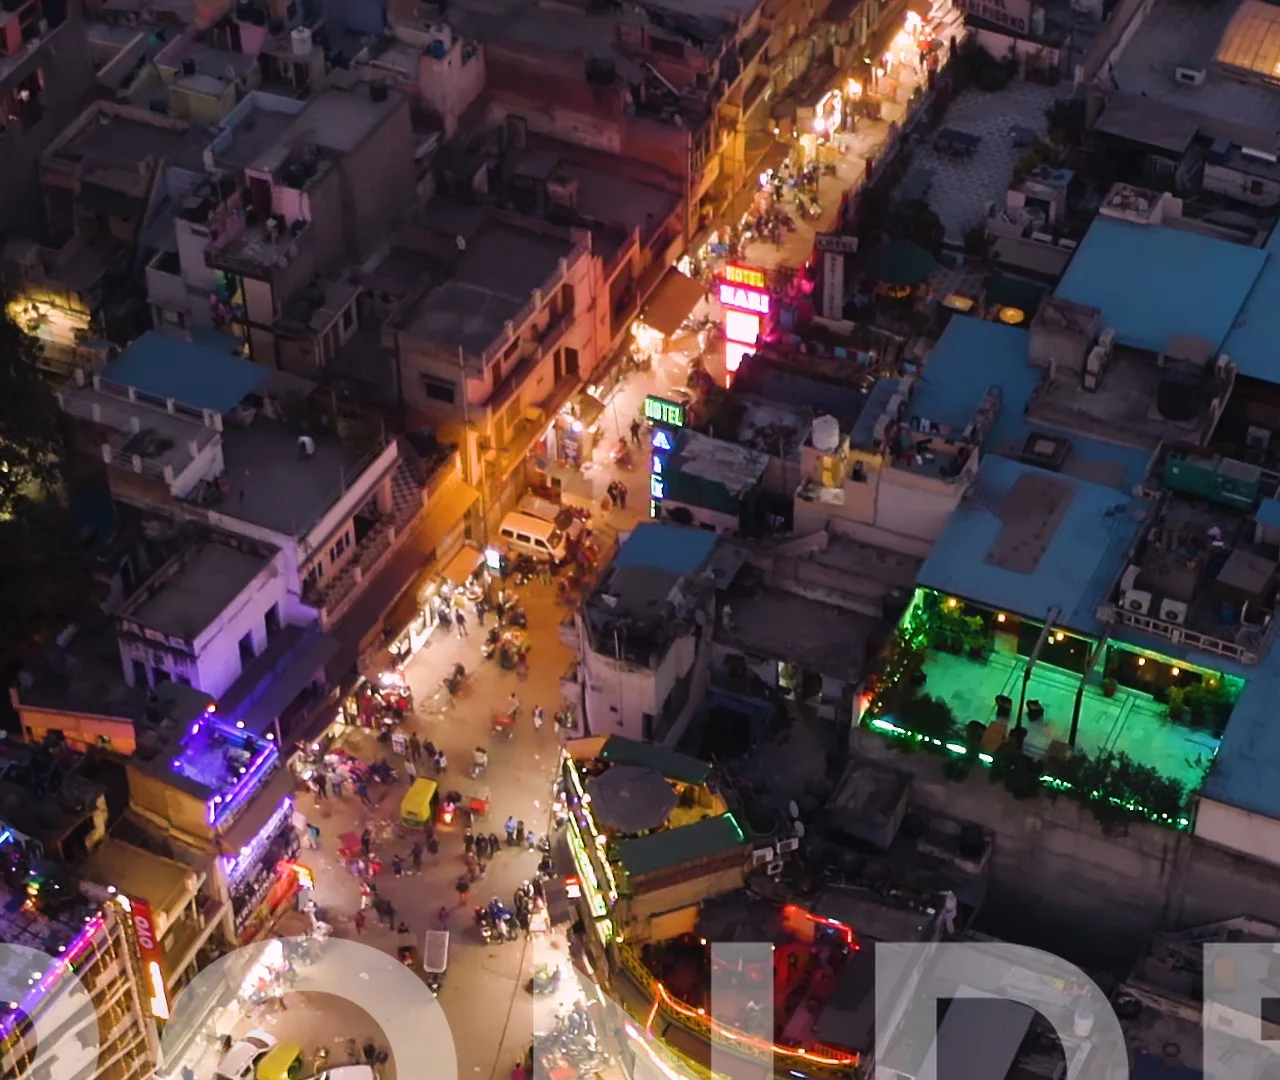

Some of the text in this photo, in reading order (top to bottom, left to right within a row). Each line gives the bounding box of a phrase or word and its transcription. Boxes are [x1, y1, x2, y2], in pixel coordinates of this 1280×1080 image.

[725, 264, 765, 287] HOTEL
[644, 398, 683, 427] HOTEL
[134, 916, 154, 949] OYO
